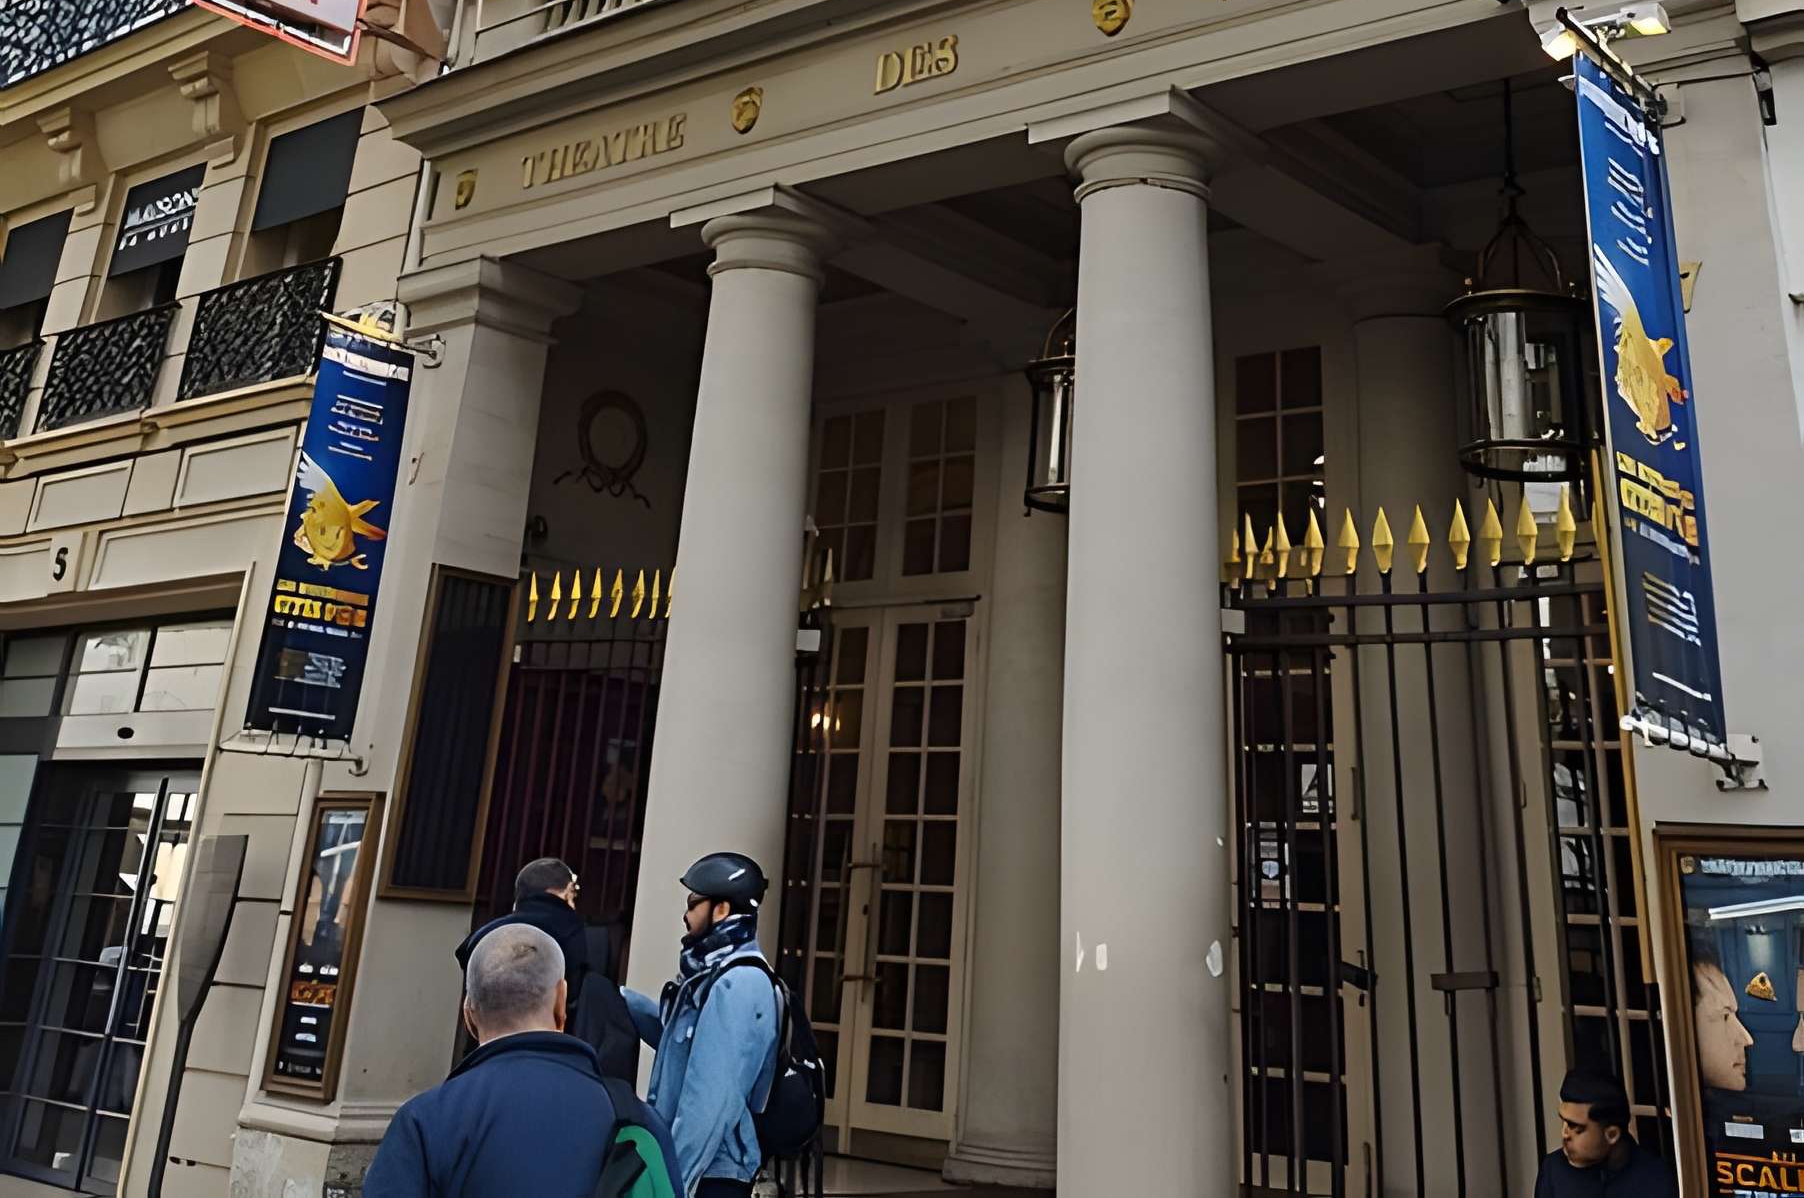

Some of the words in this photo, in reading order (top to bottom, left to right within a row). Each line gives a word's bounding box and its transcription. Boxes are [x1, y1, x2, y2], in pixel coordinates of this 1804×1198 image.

[873, 34, 959, 95] DES
[52, 546, 69, 581] 5
[1716, 1160, 1804, 1192] SCAL
